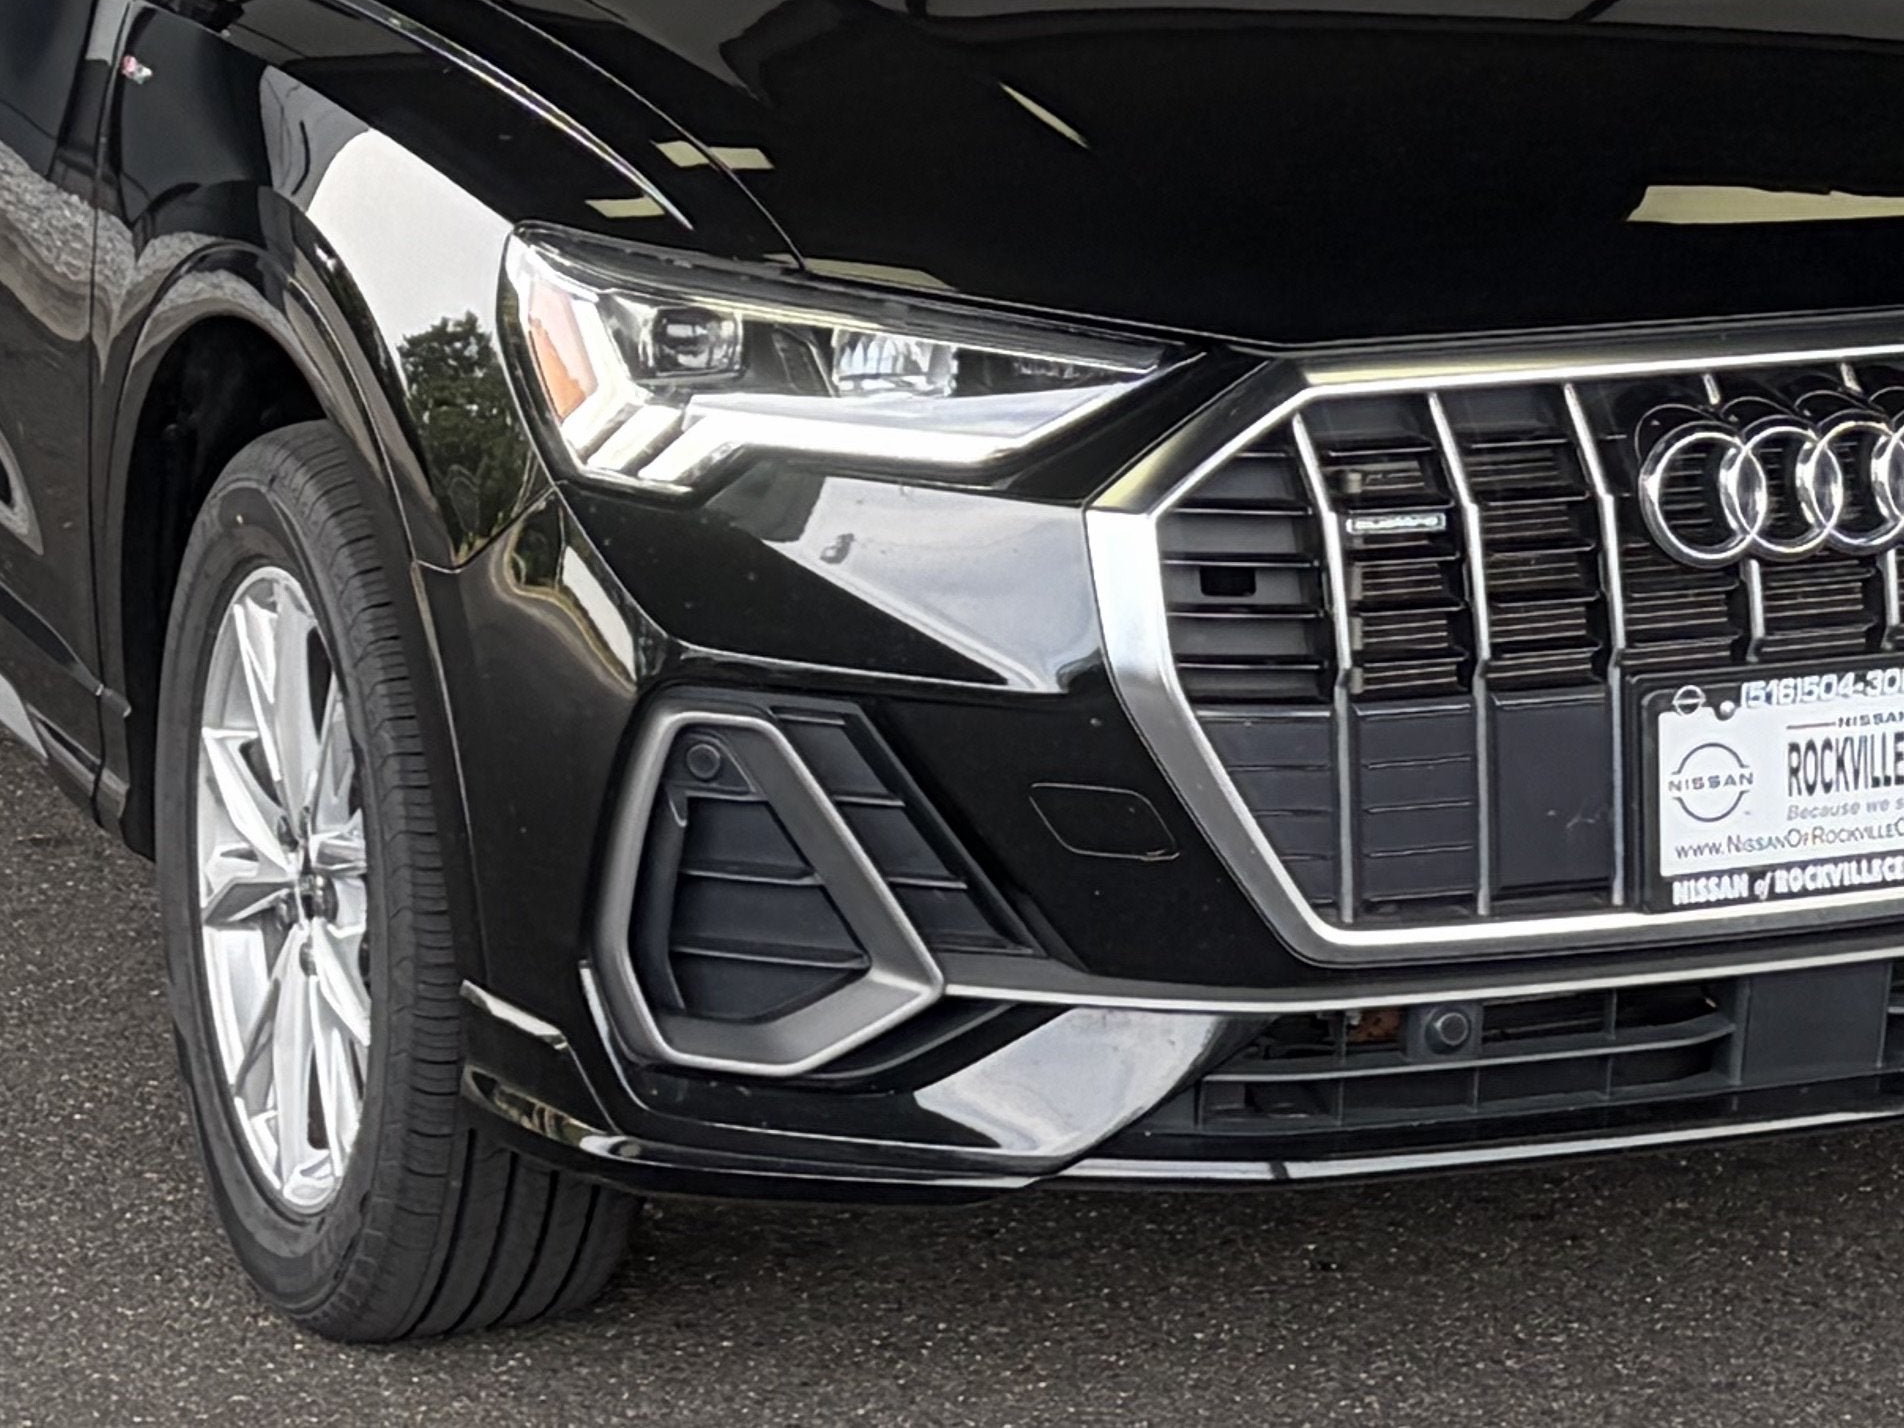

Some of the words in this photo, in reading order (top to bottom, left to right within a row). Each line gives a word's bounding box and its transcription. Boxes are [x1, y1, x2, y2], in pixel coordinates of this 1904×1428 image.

[1667, 771, 1754, 793] NISSAN
[1786, 800, 1861, 822] Because
[1866, 798, 1891, 814] we
[1671, 872, 1750, 906] NISSAN
[1753, 871, 1773, 902] of
